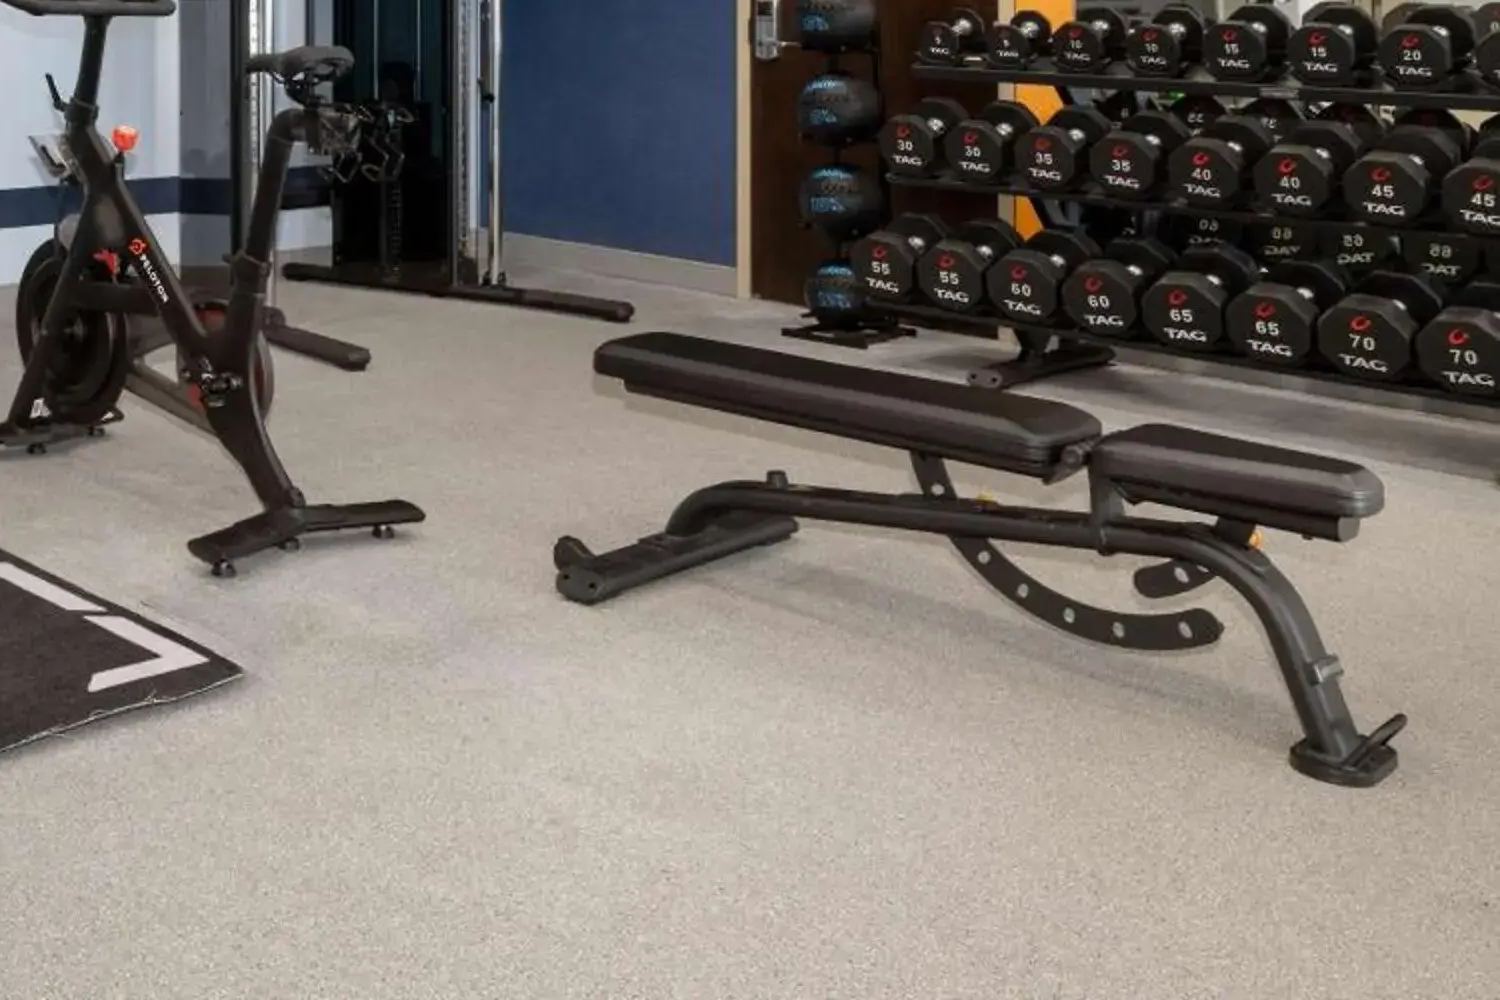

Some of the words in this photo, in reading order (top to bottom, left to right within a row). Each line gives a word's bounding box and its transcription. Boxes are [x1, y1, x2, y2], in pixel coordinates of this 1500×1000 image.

[1403, 50, 1422, 62] 20
[1218, 58, 1250, 69] TAG
[1303, 61, 1338, 73] TAG
[1396, 65, 1432, 77] TAG
[892, 155, 923, 166] TAG
[1035, 152, 1053, 165] 35
[958, 161, 991, 173] TAG
[1112, 159, 1131, 173] 35
[1028, 167, 1062, 181] TAG
[1191, 168, 1212, 181] 40
[1104, 175, 1140, 190] TAG
[1279, 177, 1300, 189] 40
[1182, 183, 1221, 198] TAG
[1371, 184, 1395, 198] 45
[1271, 193, 1312, 207] TAG
[1471, 192, 1496, 207] 45
[1363, 201, 1405, 217] TAG
[871, 261, 890, 275] 55
[140, 253, 170, 303] PELOTON
[865, 277, 899, 293] TAG
[939, 271, 959, 285] 55
[934, 288, 970, 303] TAG
[1011, 283, 1032, 297] 60
[1004, 300, 1042, 315] TAG
[1088, 295, 1110, 308] 60
[1083, 314, 1124, 327] TAG
[1169, 308, 1193, 323] 65
[1162, 327, 1207, 342] TAG
[1255, 321, 1280, 336] 65
[1246, 339, 1293, 357] TAG
[1349, 333, 1376, 351] 70
[1338, 353, 1388, 373] TAG
[1449, 349, 1478, 366] 70
[1441, 370, 1495, 387] TAG
